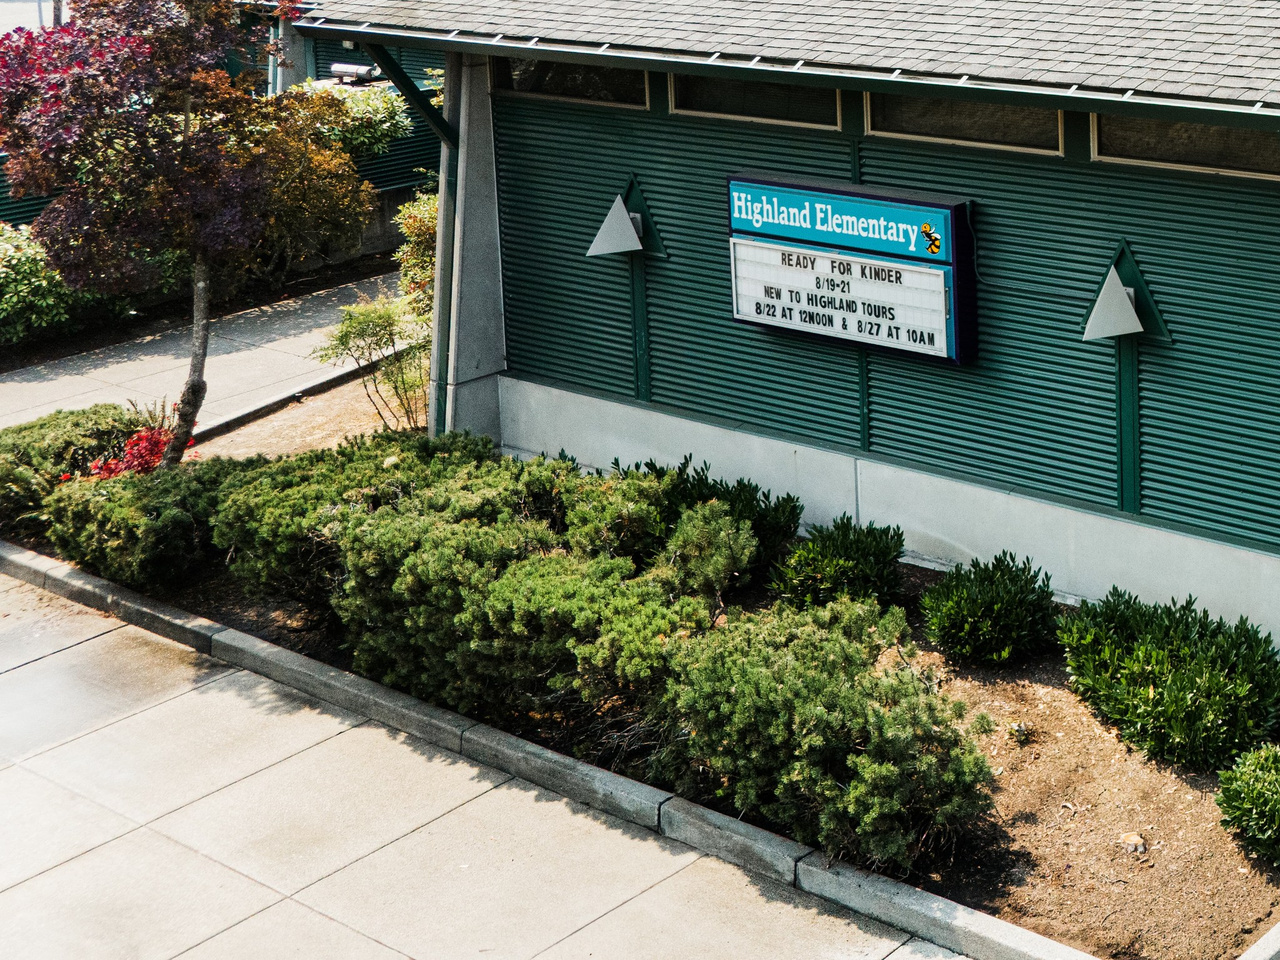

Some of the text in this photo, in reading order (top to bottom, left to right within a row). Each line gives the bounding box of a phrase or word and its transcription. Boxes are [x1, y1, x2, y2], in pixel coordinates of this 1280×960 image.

[732, 191, 918, 251] Highland Elementary
[781, 252, 902, 284] READY FOR KINDER
[815, 276, 850, 293] 8/19-21
[764, 285, 895, 320] NEW TO HIGHLAND TOURS
[755, 302, 935, 346] 8/22 AT 12NOON & 8/27 AT 10AM
